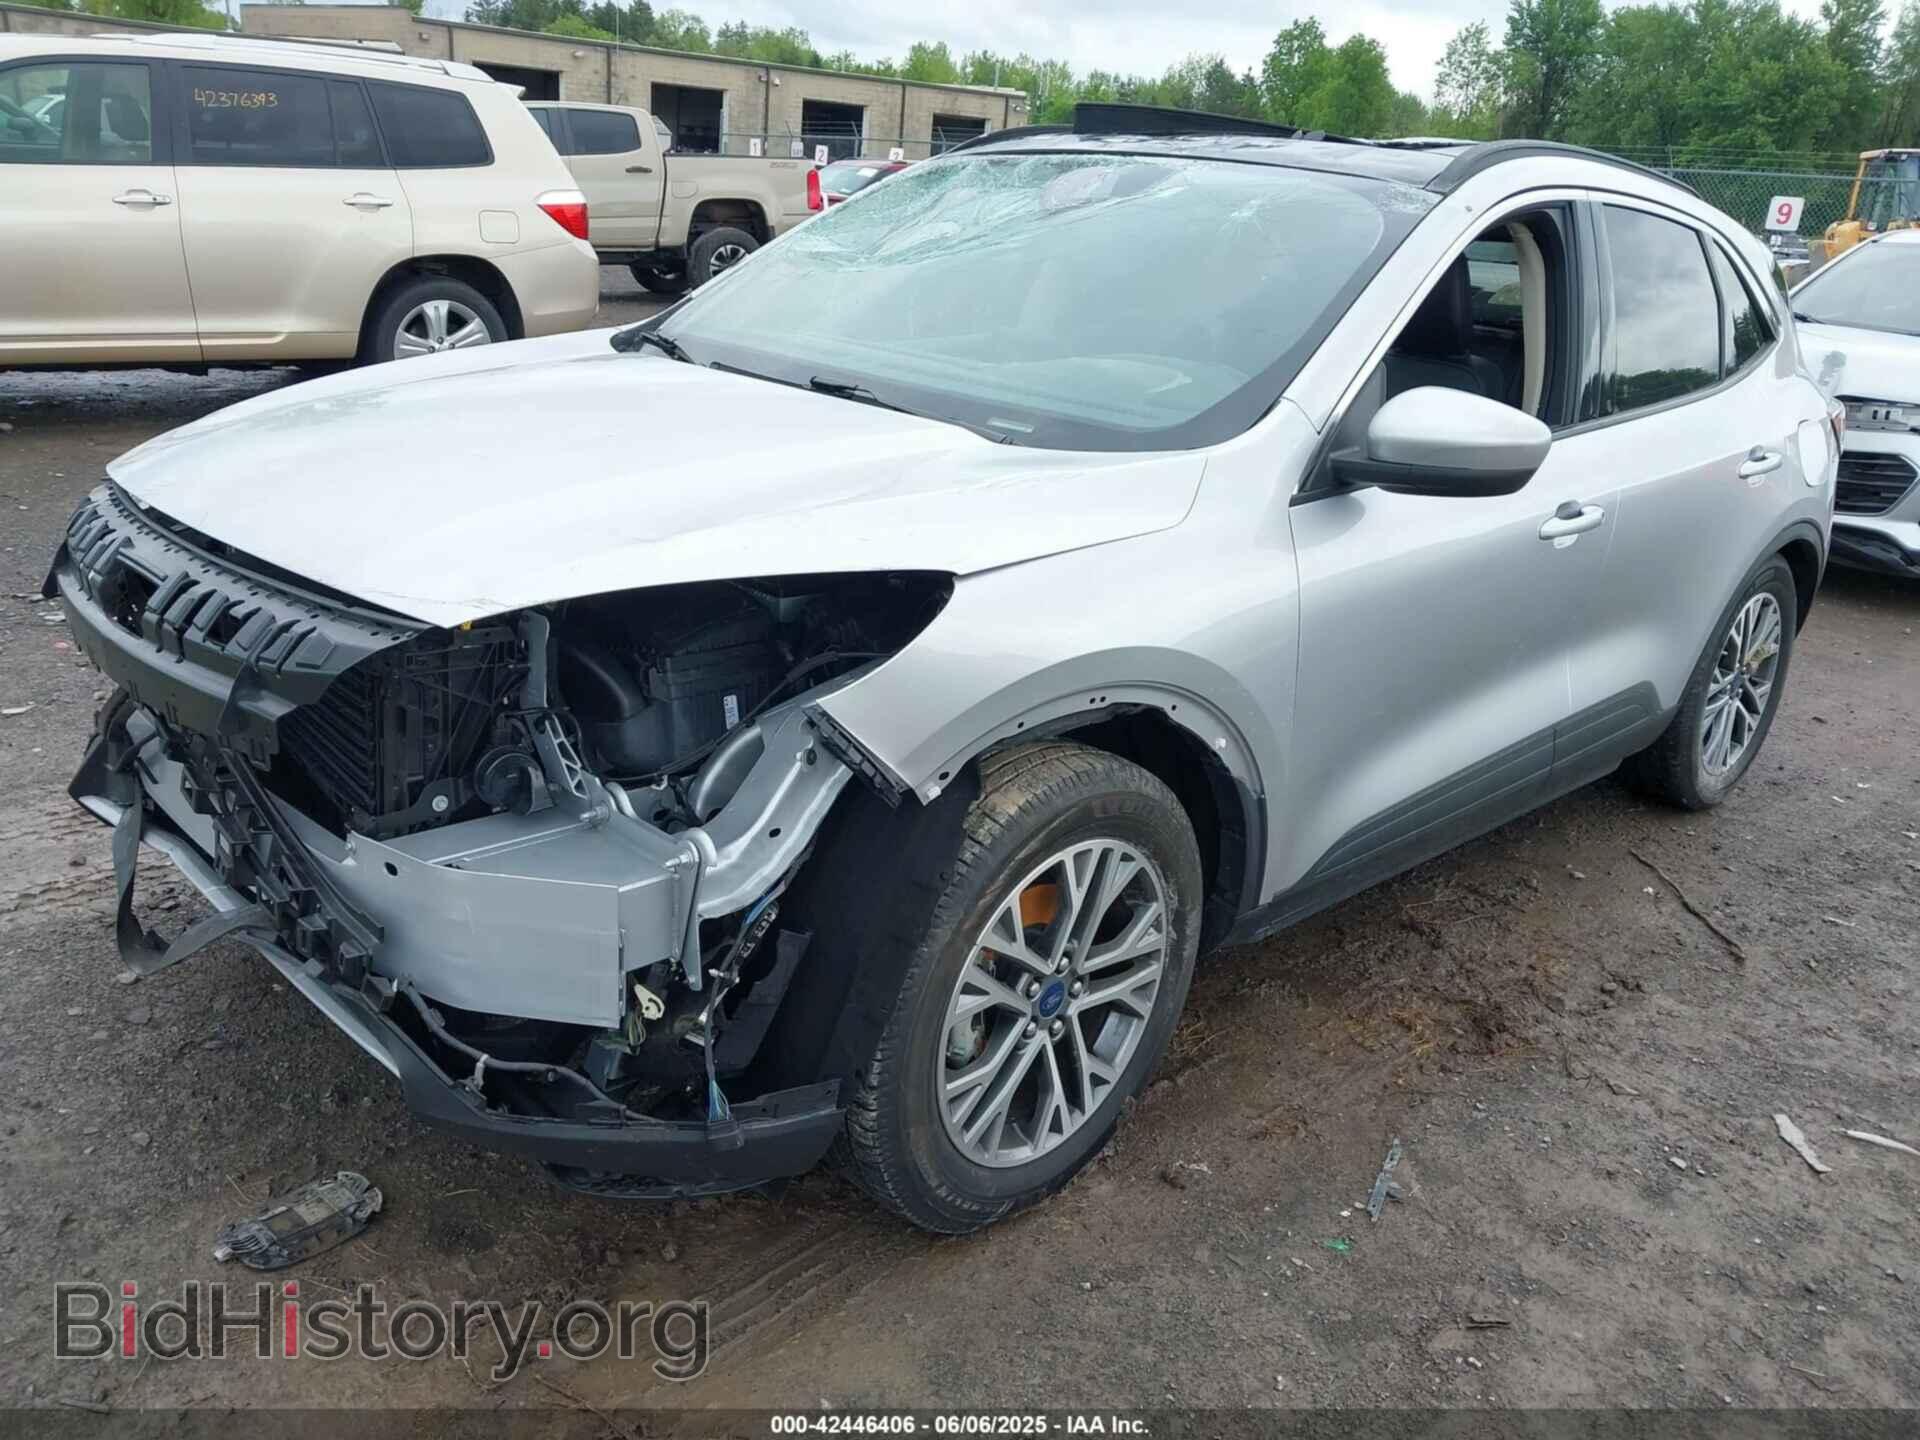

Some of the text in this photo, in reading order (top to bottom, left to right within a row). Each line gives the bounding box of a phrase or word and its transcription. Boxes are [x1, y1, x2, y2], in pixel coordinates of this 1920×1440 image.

[194, 87, 278, 108] 42376393
[817, 150, 826, 162] 2
[1776, 203, 1793, 225] 9
